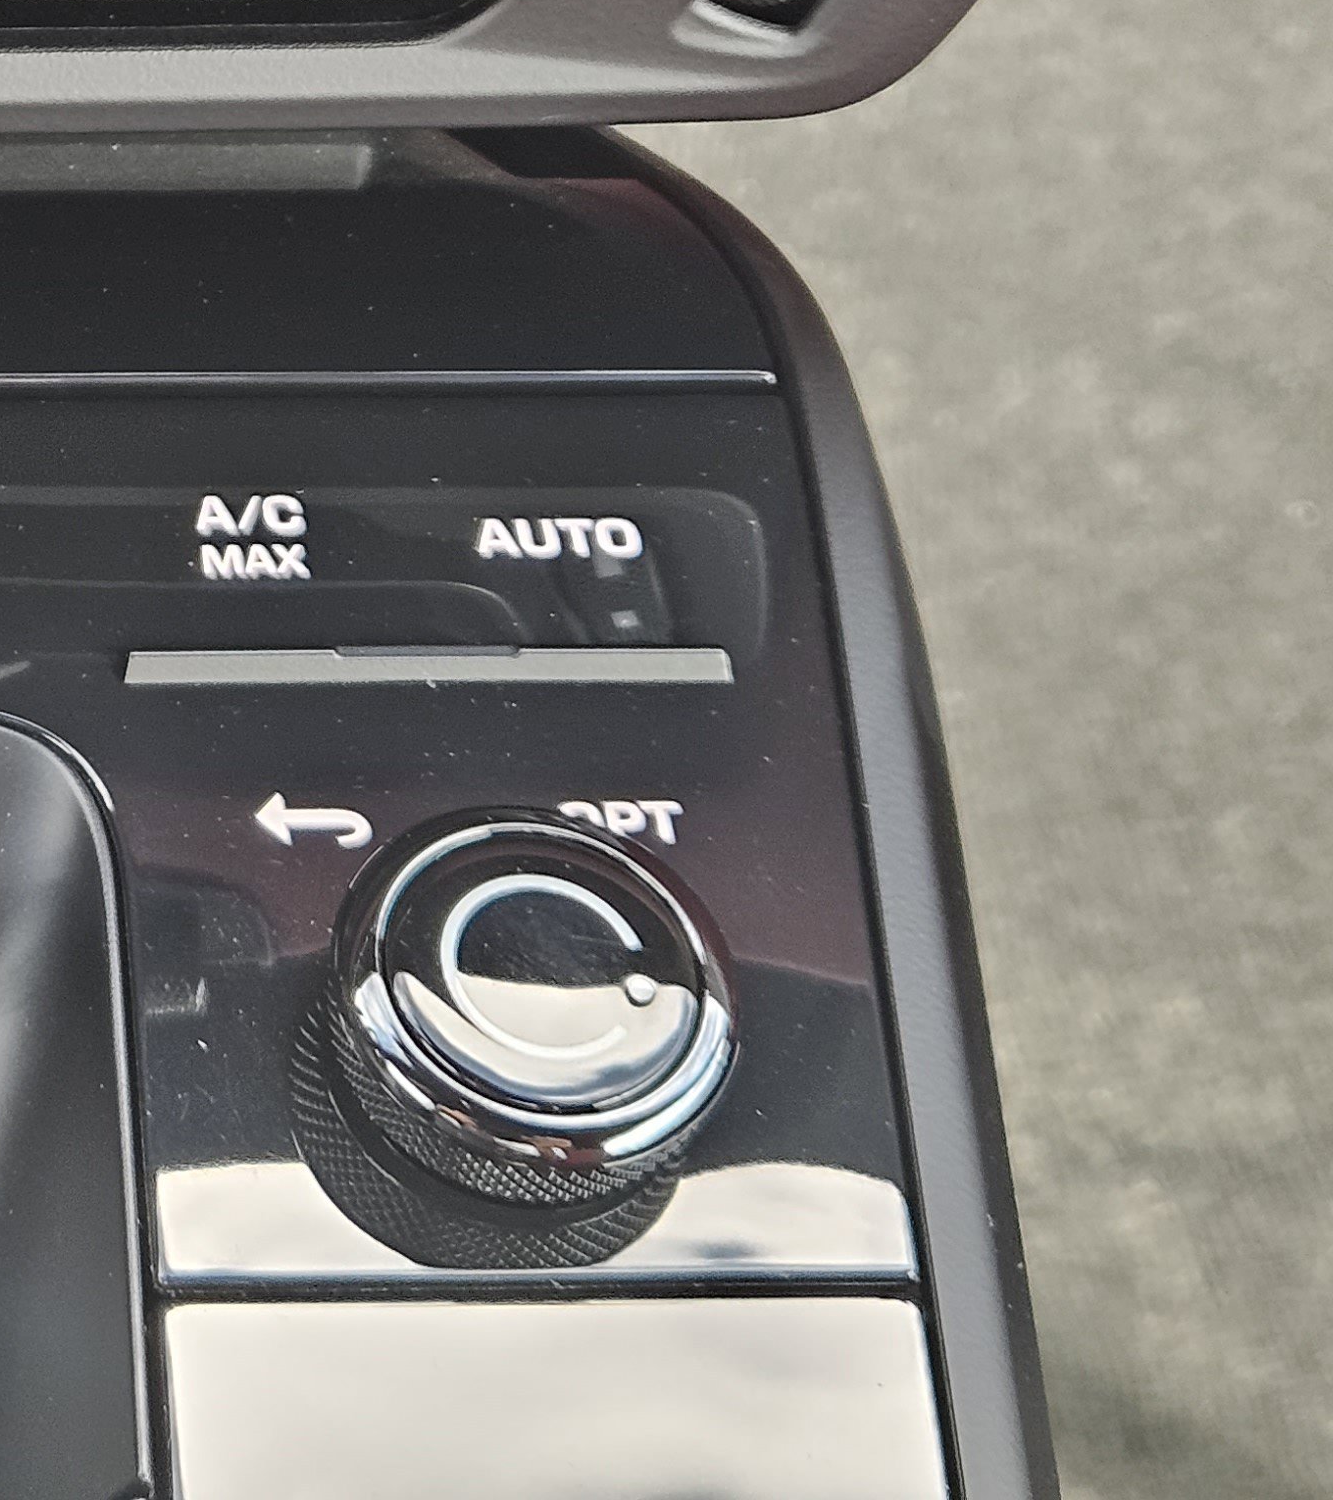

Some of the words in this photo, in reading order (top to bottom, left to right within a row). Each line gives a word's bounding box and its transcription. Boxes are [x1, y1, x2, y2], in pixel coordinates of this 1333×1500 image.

[196, 495, 307, 537] A/C
[475, 518, 643, 559] AUTO
[200, 543, 311, 580] MAX
